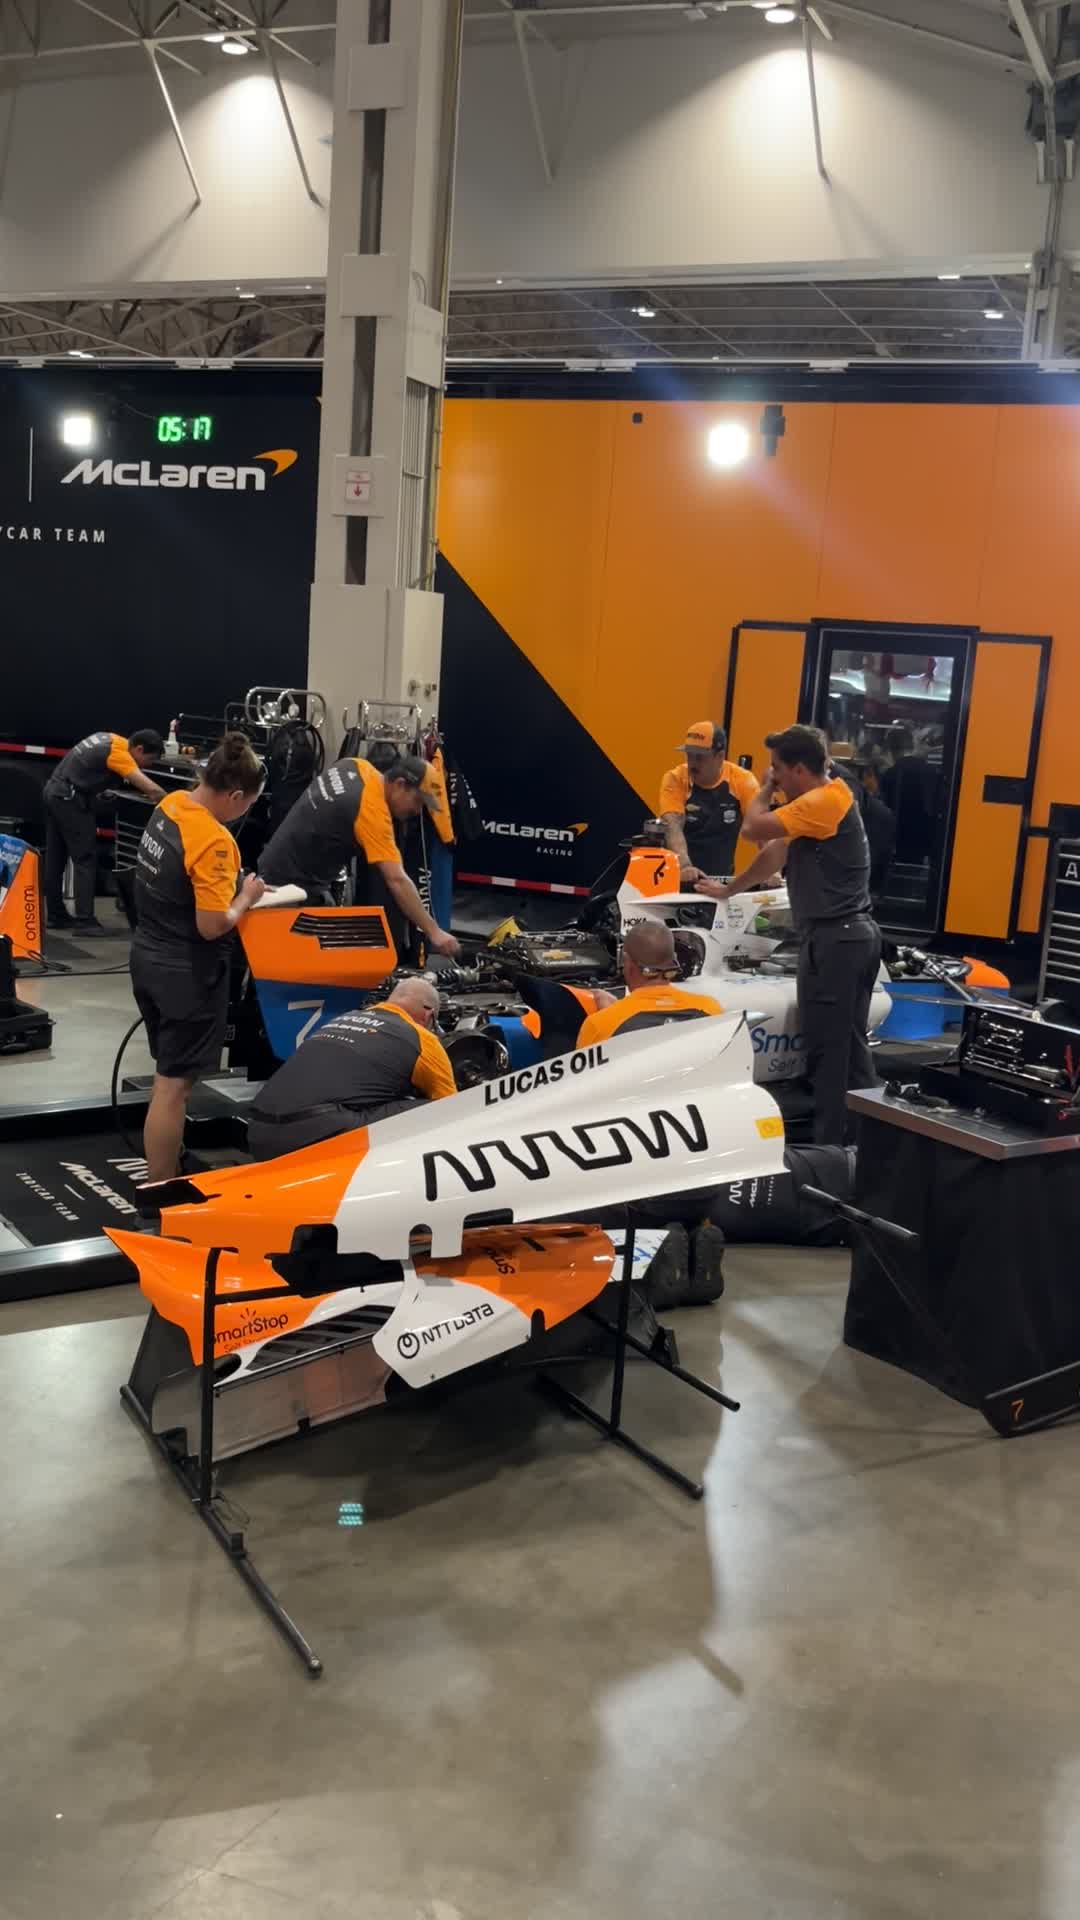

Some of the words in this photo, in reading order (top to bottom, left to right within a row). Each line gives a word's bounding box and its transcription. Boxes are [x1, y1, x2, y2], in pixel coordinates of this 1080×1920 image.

[158, 416, 211, 441] 05:17
[60, 459, 265, 491] McLaren
[54, 528, 105, 543] TEAM
[536, 846, 573, 857] RACING
[485, 1060, 564, 1107] LUCAS
[570, 1045, 609, 1074] OIL
[58, 1161, 138, 1214] McLaren
[213, 1313, 289, 1344] martStop
[421, 1321, 452, 1345] NTT
